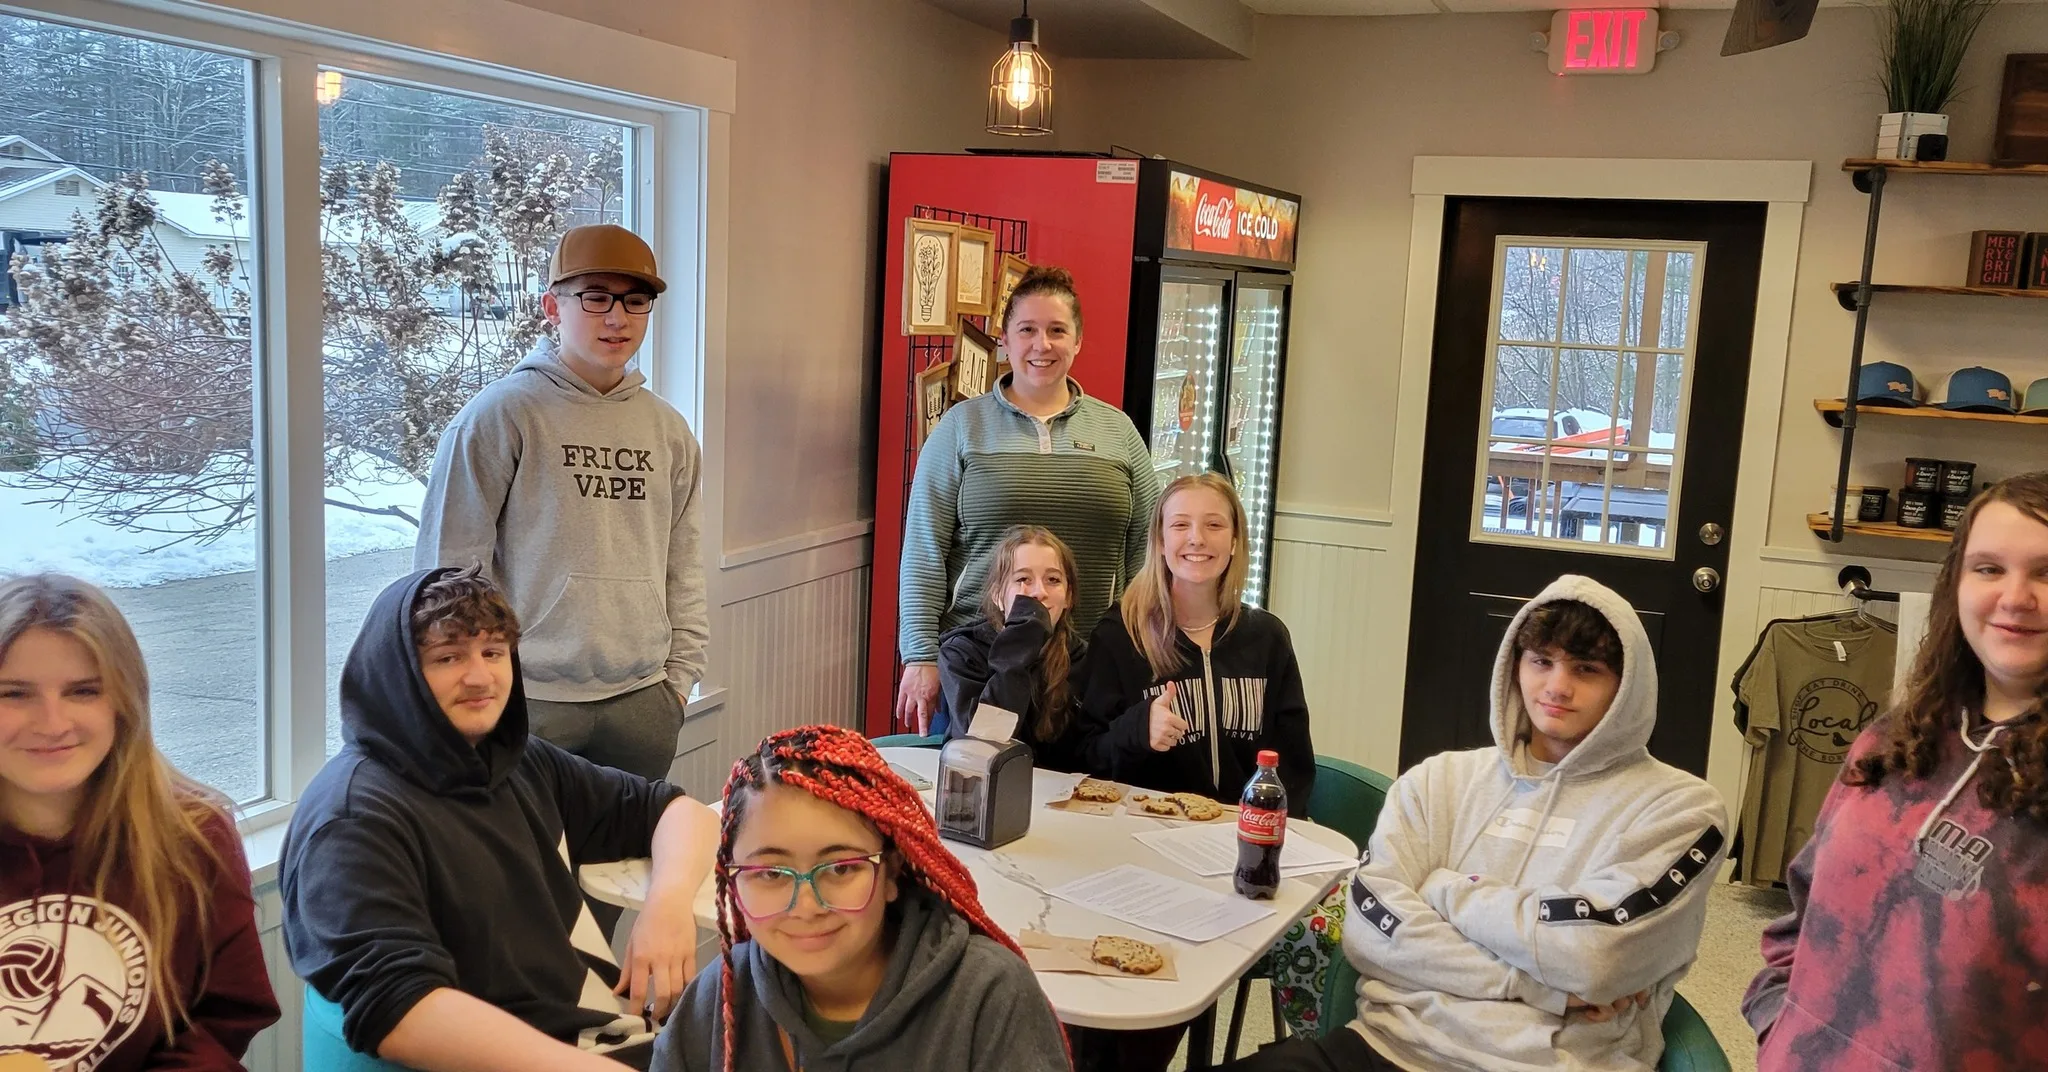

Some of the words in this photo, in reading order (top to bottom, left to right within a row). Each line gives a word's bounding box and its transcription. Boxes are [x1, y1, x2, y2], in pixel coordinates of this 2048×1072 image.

[1565, 10, 1648, 68] EXIT
[1237, 211, 1252, 237] ICE
[1254, 215, 1278, 240] COLD
[1987, 236, 2016, 248] MER
[1983, 271, 2009, 283] GHT
[1984, 260, 2011, 272] BRI
[561, 444, 654, 472] FRICK
[573, 473, 646, 501] VAPE
[1806, 680, 1826, 693] EAT
[1832, 680, 1864, 699] DRINK
[1787, 696, 1878, 746] Local
[94, 911, 147, 1024] JUNIORS
